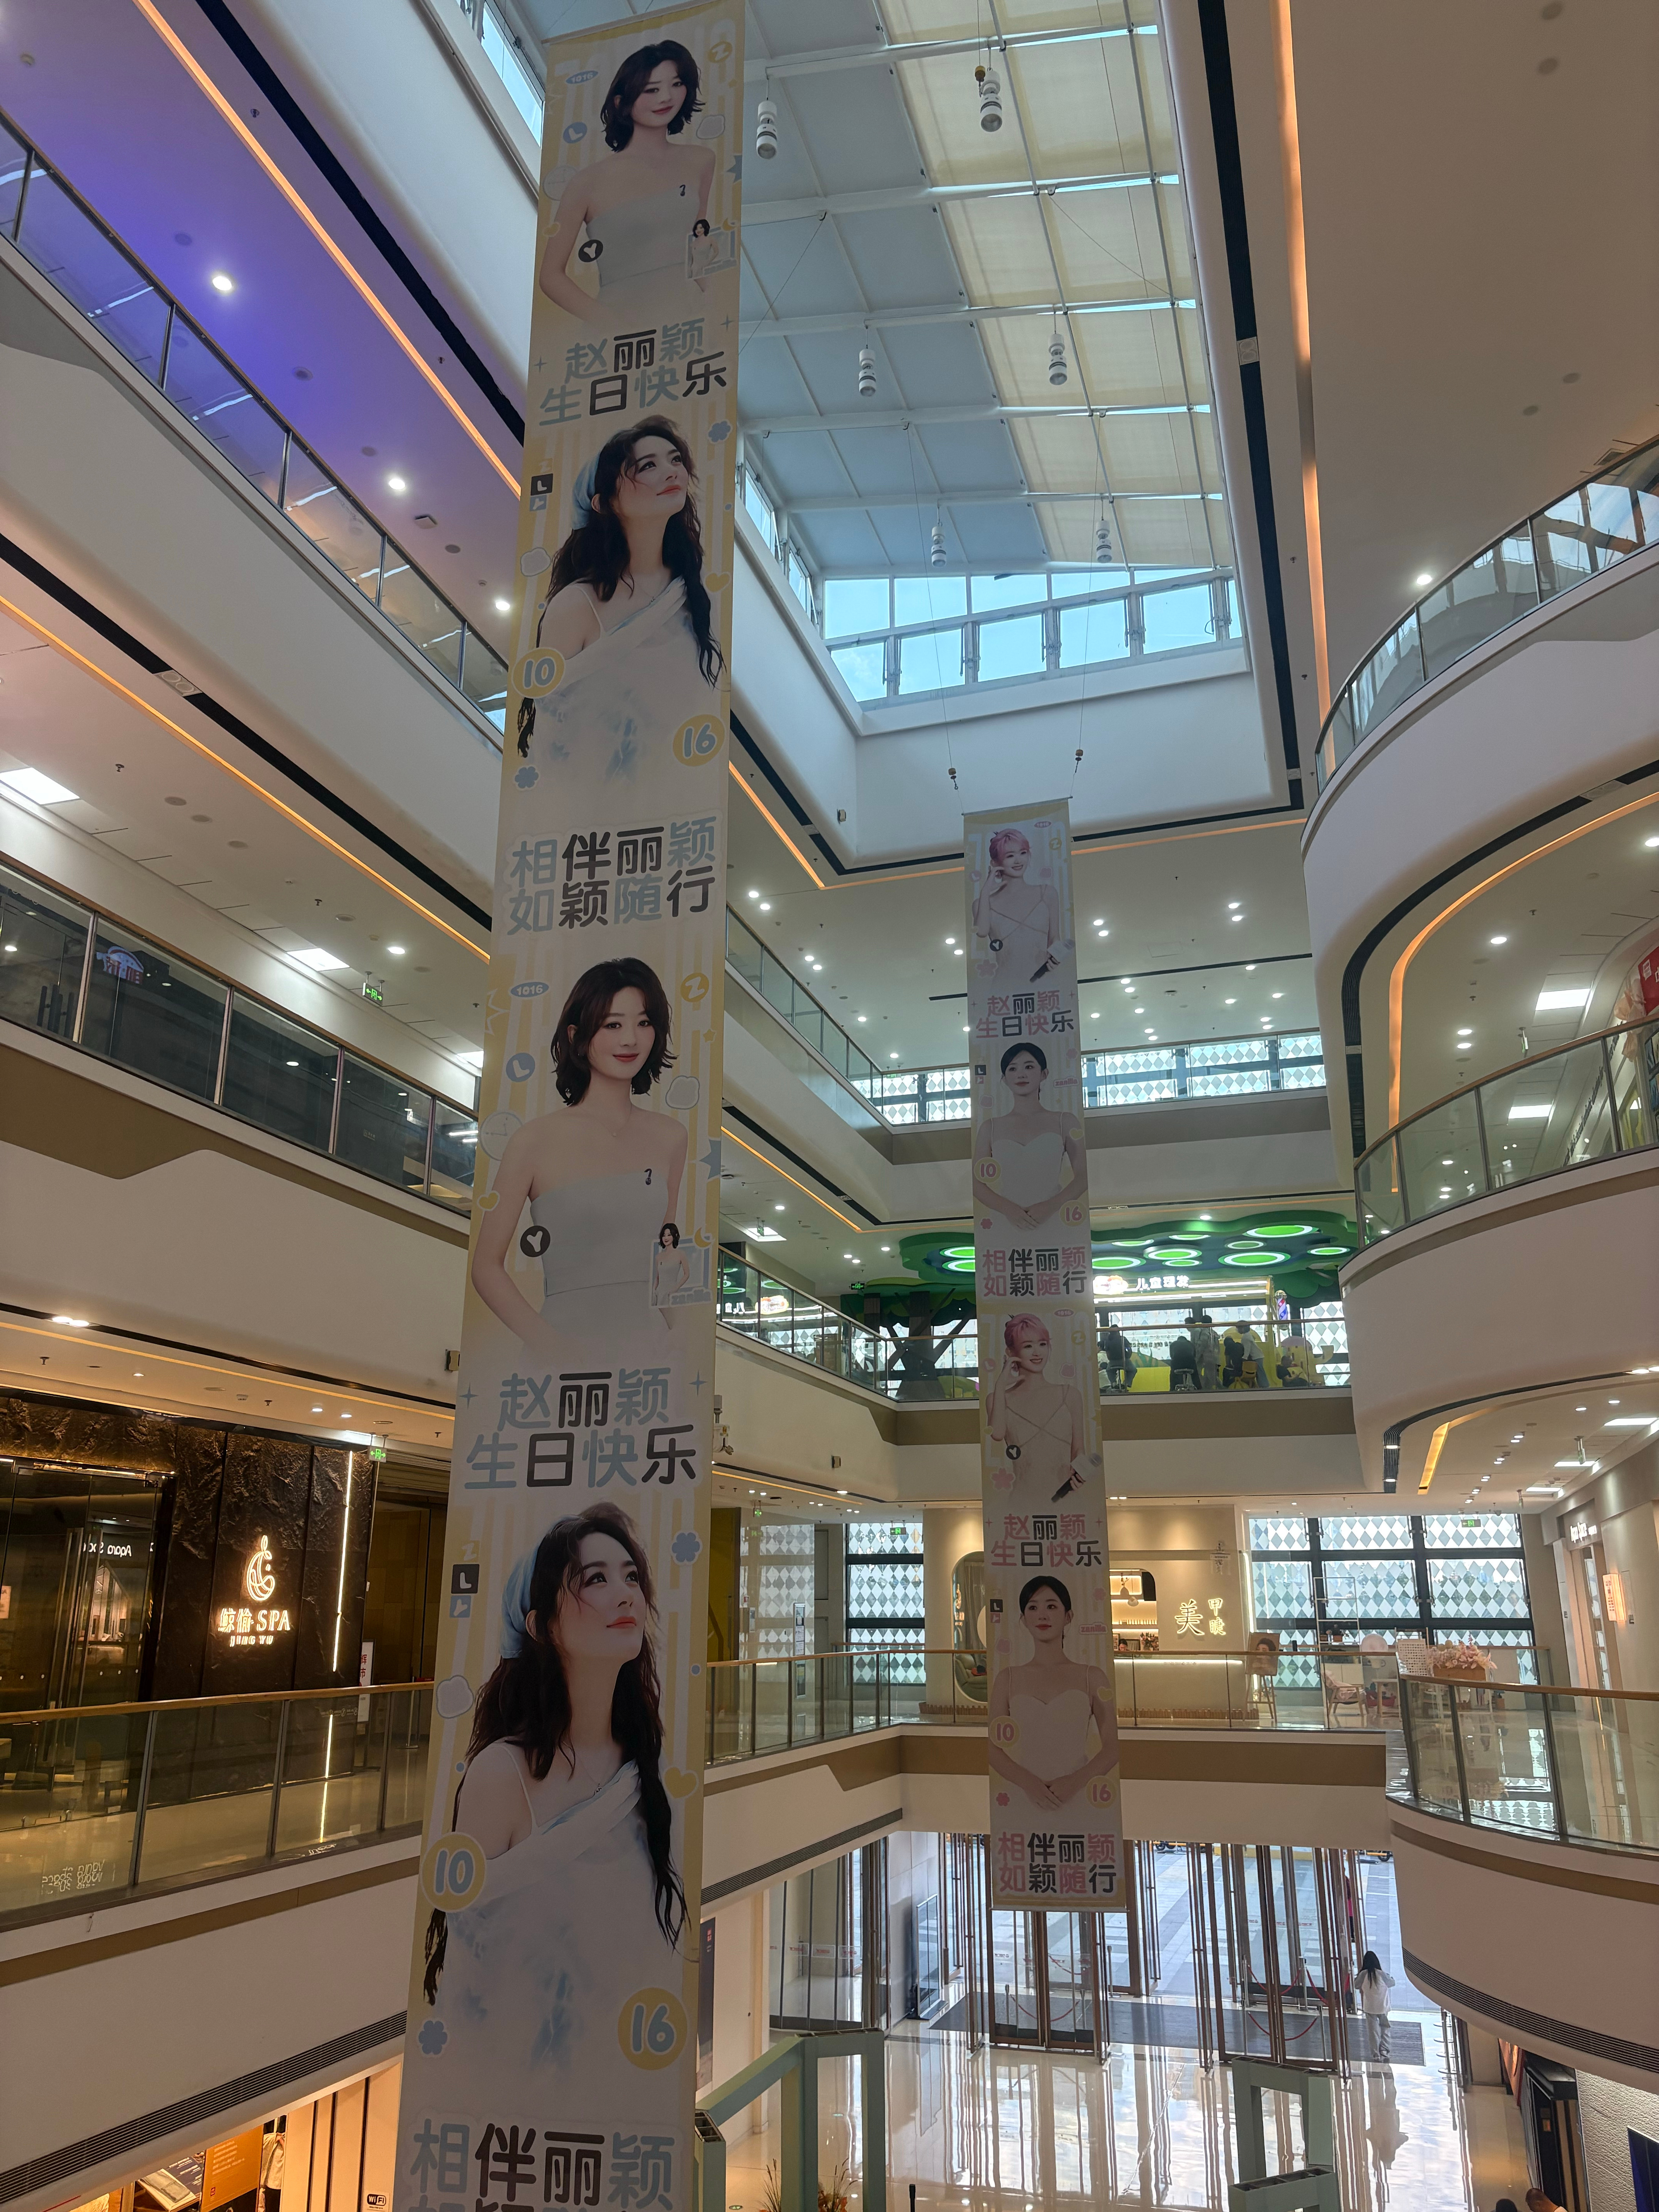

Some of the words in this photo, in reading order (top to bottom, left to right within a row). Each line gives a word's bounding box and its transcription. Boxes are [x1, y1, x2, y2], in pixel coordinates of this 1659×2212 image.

[571, 72, 594, 82] 1016
[565, 318, 704, 384] 赵丽颖
[539, 351, 727, 426] 生日快乐
[524, 658, 555, 688] 10
[684, 725, 716, 758] 16
[510, 816, 716, 889] 相伴丽颖
[507, 866, 715, 936] 如颖随行
[517, 985, 543, 995] 1016
[987, 990, 1060, 1017] 赵丽颖
[976, 1010, 1074, 1039] 生日快乐
[980, 1163, 996, 1177] 10
[1065, 1207, 1082, 1222] 16
[982, 1246, 1086, 1273] 相伴丽颖
[984, 1271, 1087, 1297] 如颖随行
[498, 1367, 670, 1432] 赵丽颖
[465, 1425, 696, 1489] 生日快乐
[1004, 1513, 1086, 1540] 赵丽颖
[991, 1540, 1101, 1567] 生日快乐
[230, 1635, 256, 1647] JING
[259, 1635, 273, 1645] YU
[996, 1724, 1014, 1741] 10
[1092, 1784, 1111, 1802] 16
[998, 1831, 1115, 1863] 相伴丽颖
[435, 1850, 474, 1894] 10
[1000, 1864, 1116, 1894] 如颖随行
[632, 2004, 675, 2052] 16
[410, 2118, 675, 2210] 相伴丽颖
